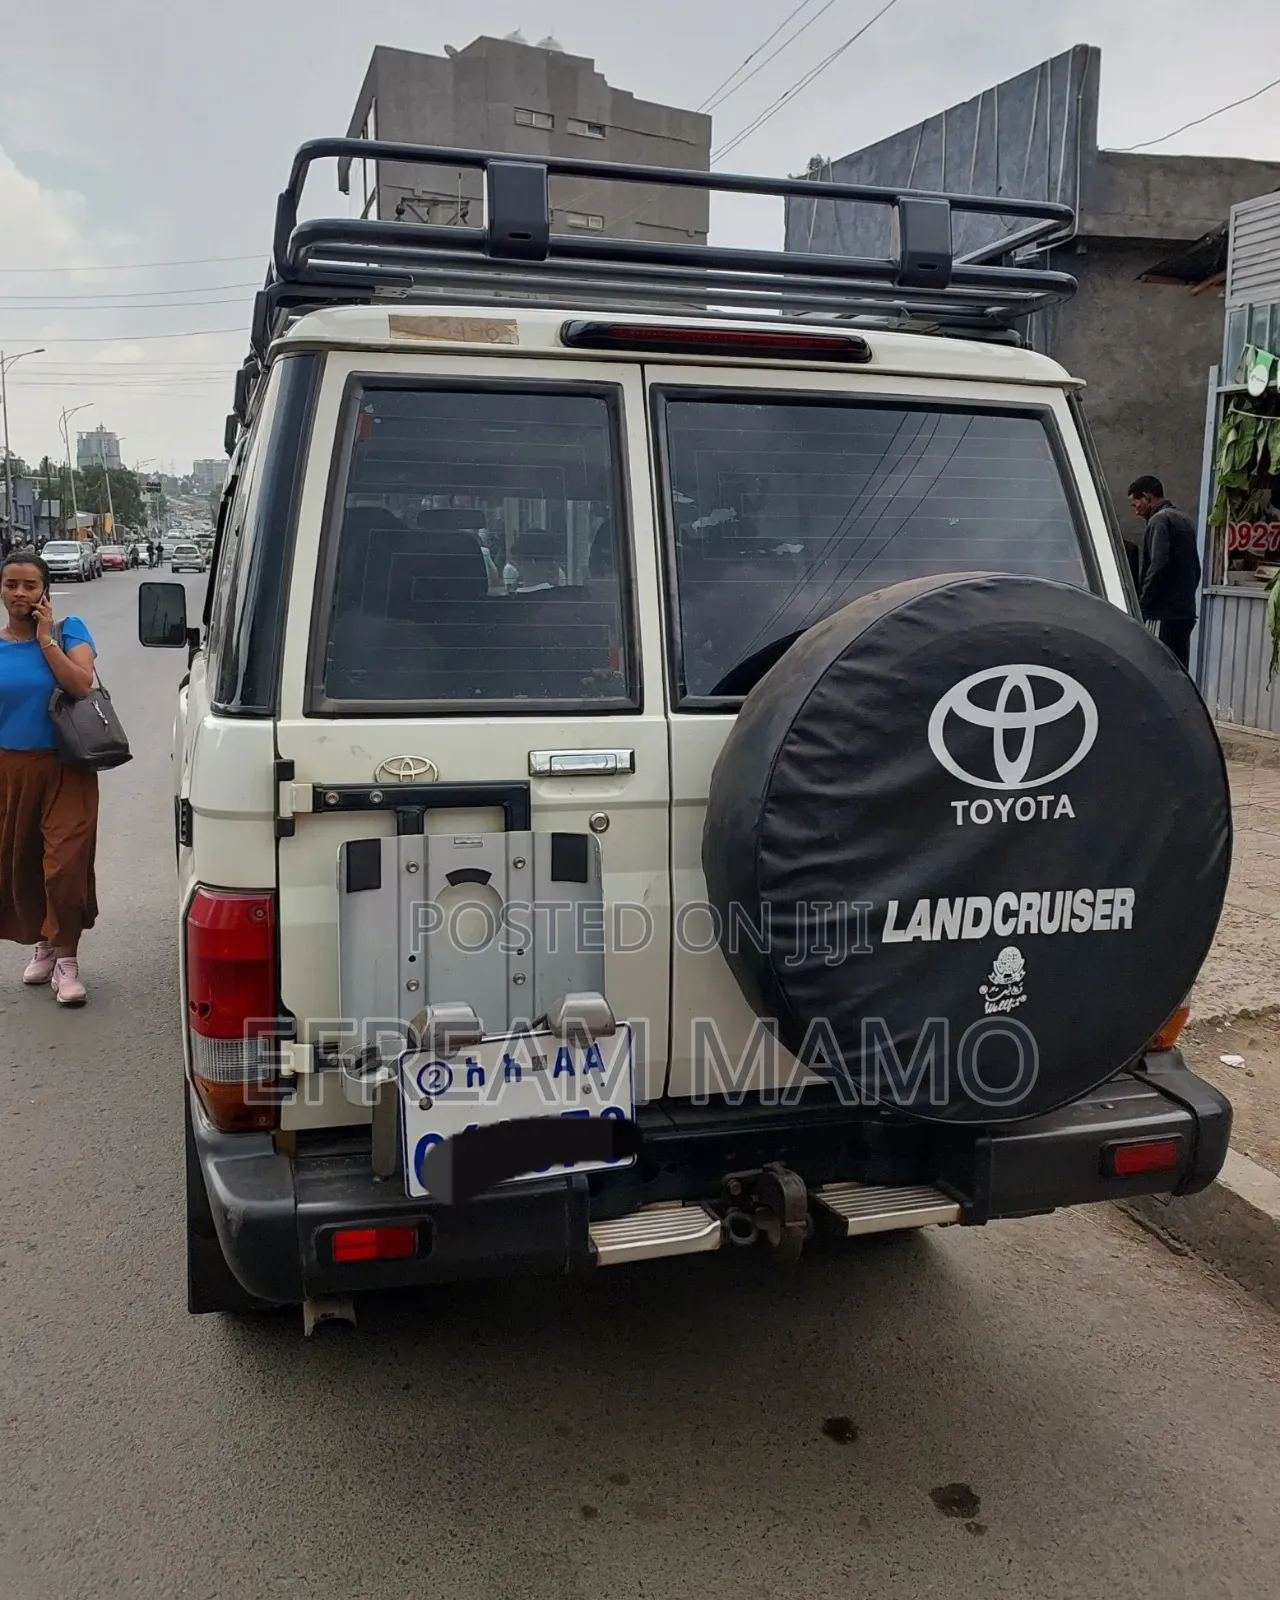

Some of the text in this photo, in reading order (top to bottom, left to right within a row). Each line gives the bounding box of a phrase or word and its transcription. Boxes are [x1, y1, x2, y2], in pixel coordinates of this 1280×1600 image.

[951, 794, 1076, 825] TOYOTA
[881, 887, 1136, 943] LANDCRUISER
[553, 1043, 606, 1078] AA
